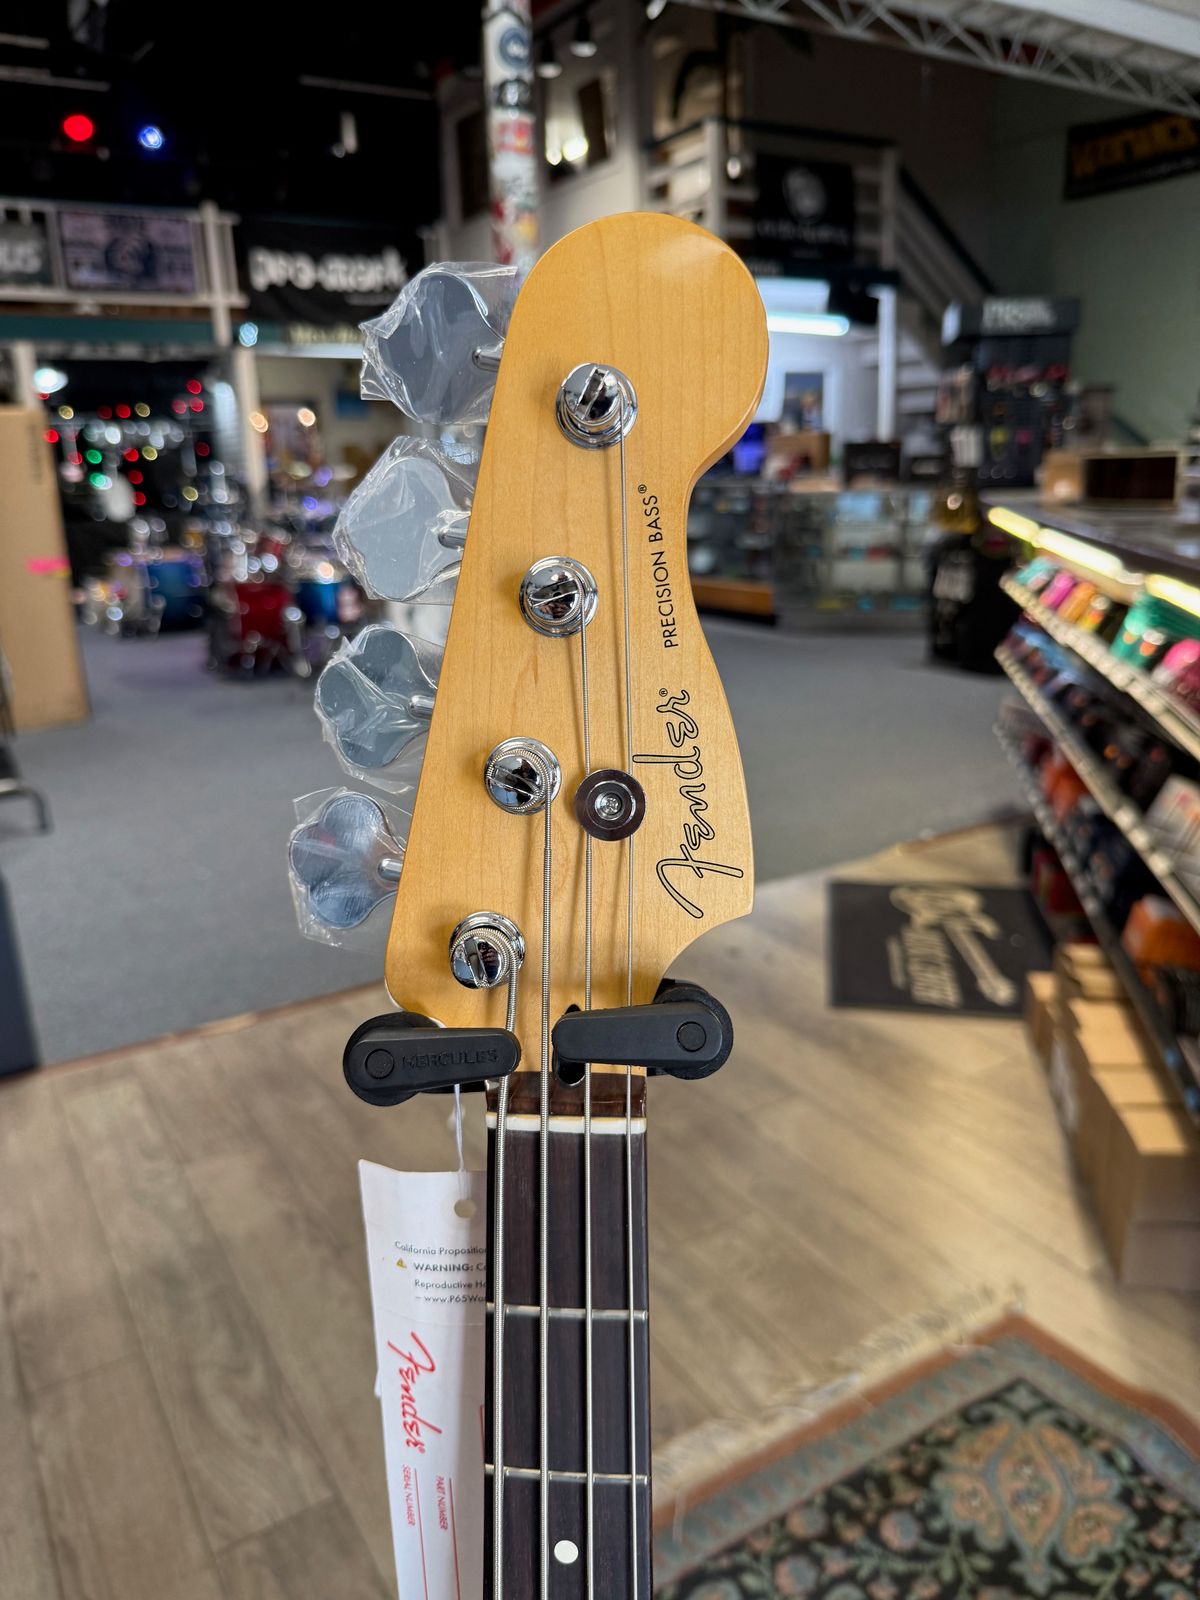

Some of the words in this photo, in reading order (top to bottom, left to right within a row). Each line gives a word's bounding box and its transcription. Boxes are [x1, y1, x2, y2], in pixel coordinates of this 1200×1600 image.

[650, 551, 679, 648] PRECISION
[402, 1047, 498, 1070] HERCULES
[394, 1240, 437, 1255] California
[413, 1261, 474, 1272] WARNING:
[414, 1278, 473, 1291] Reproductive
[436, 1475, 446, 1495] PART
[405, 1493, 416, 1527] NUMBER
[438, 1496, 449, 1531] NUMBER
